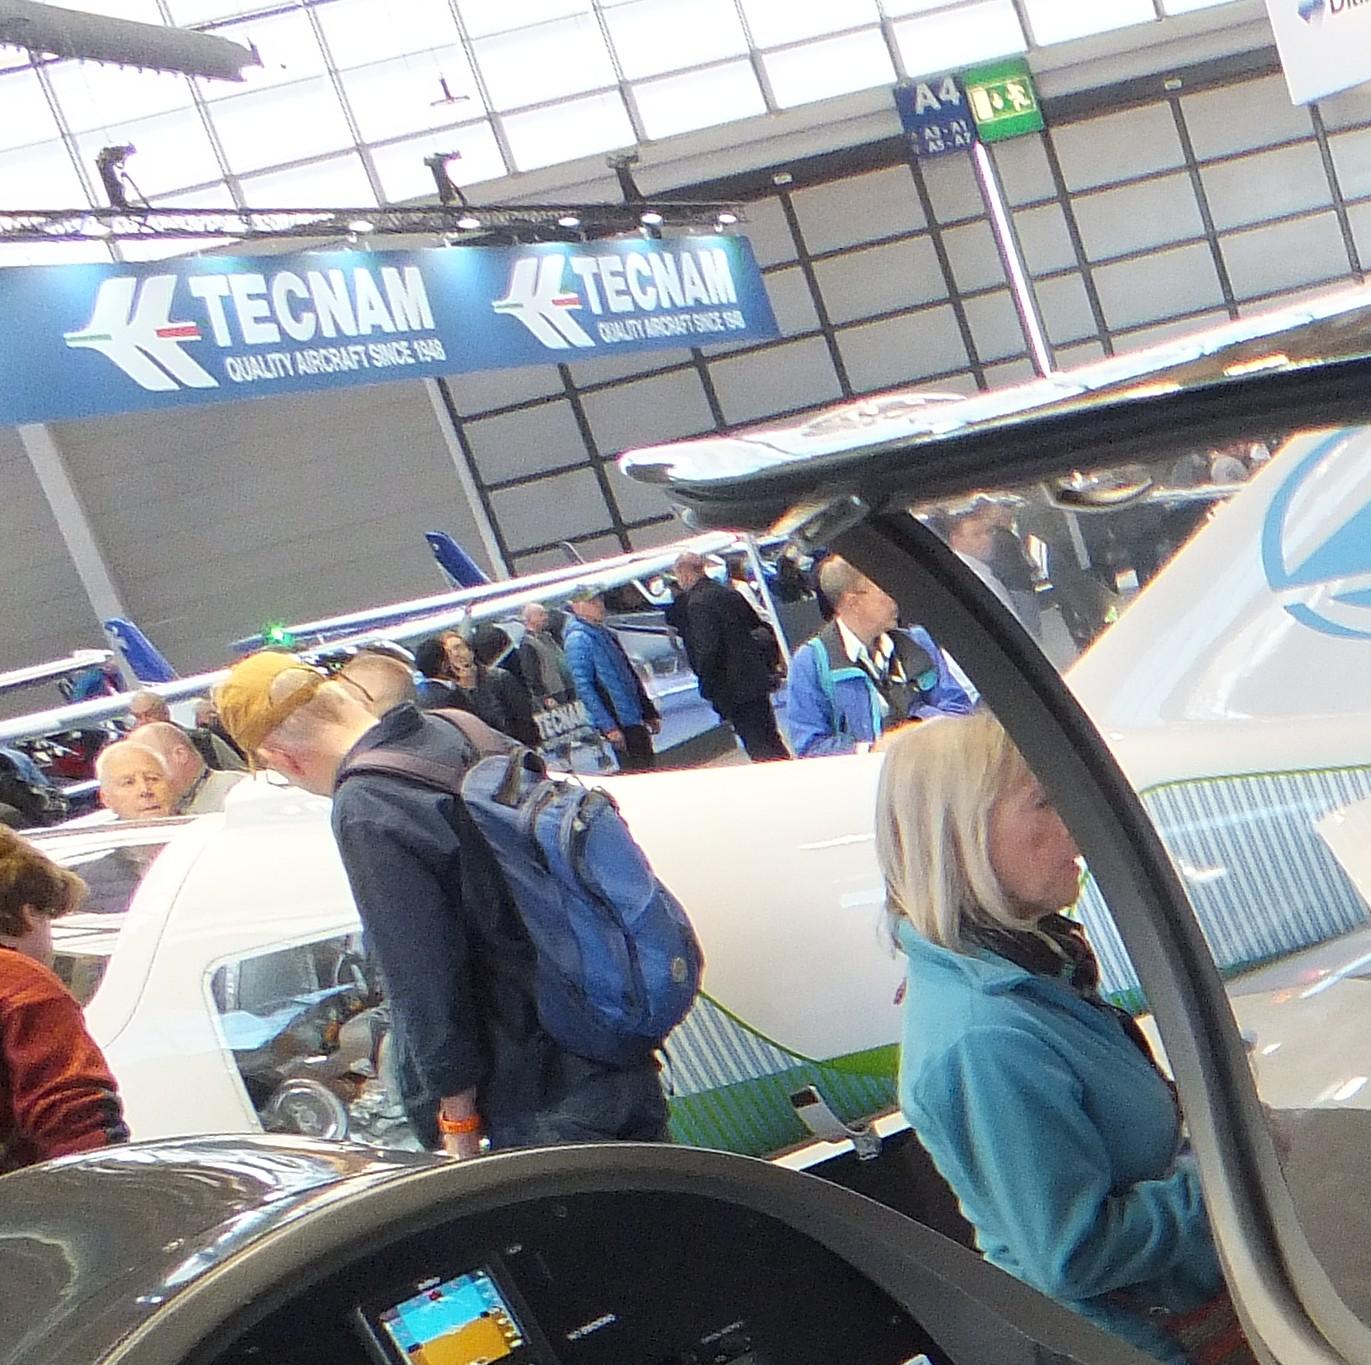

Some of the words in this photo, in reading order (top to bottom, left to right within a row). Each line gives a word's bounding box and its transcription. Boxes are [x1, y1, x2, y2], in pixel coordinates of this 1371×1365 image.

[916, 75, 961, 115] A4
[570, 249, 737, 315] TECNAM
[188, 266, 436, 347] TECNAM
[598, 319, 646, 343] QUALITY
[225, 353, 295, 383] QUALITY
[296, 345, 369, 376] AIRCRAFT
[366, 340, 416, 367] SINCE
